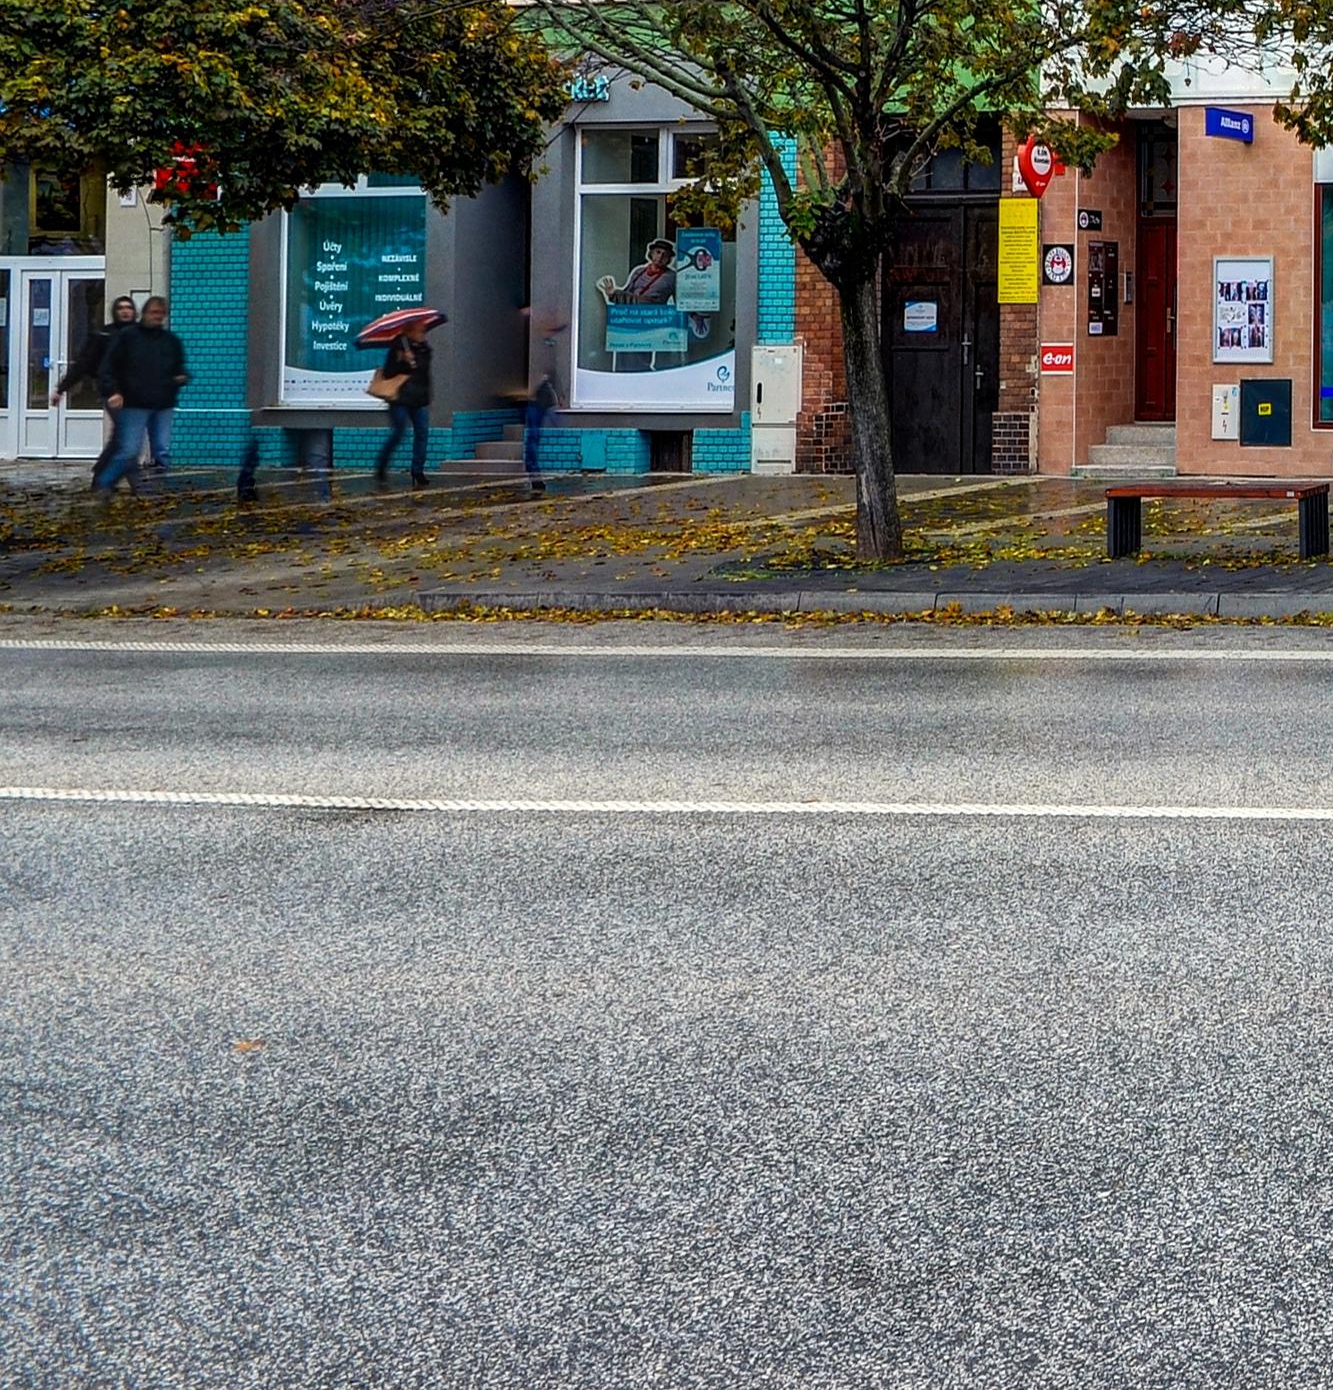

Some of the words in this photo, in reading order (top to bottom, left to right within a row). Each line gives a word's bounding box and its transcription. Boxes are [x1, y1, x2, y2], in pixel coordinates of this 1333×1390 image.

[323, 239, 342, 254] Účty
[316, 260, 348, 273] Spoření
[314, 280, 348, 293] Pojištění
[319, 299, 343, 313] Úvěry
[311, 321, 350, 333] Hypotéky
[313, 340, 348, 350] Investice
